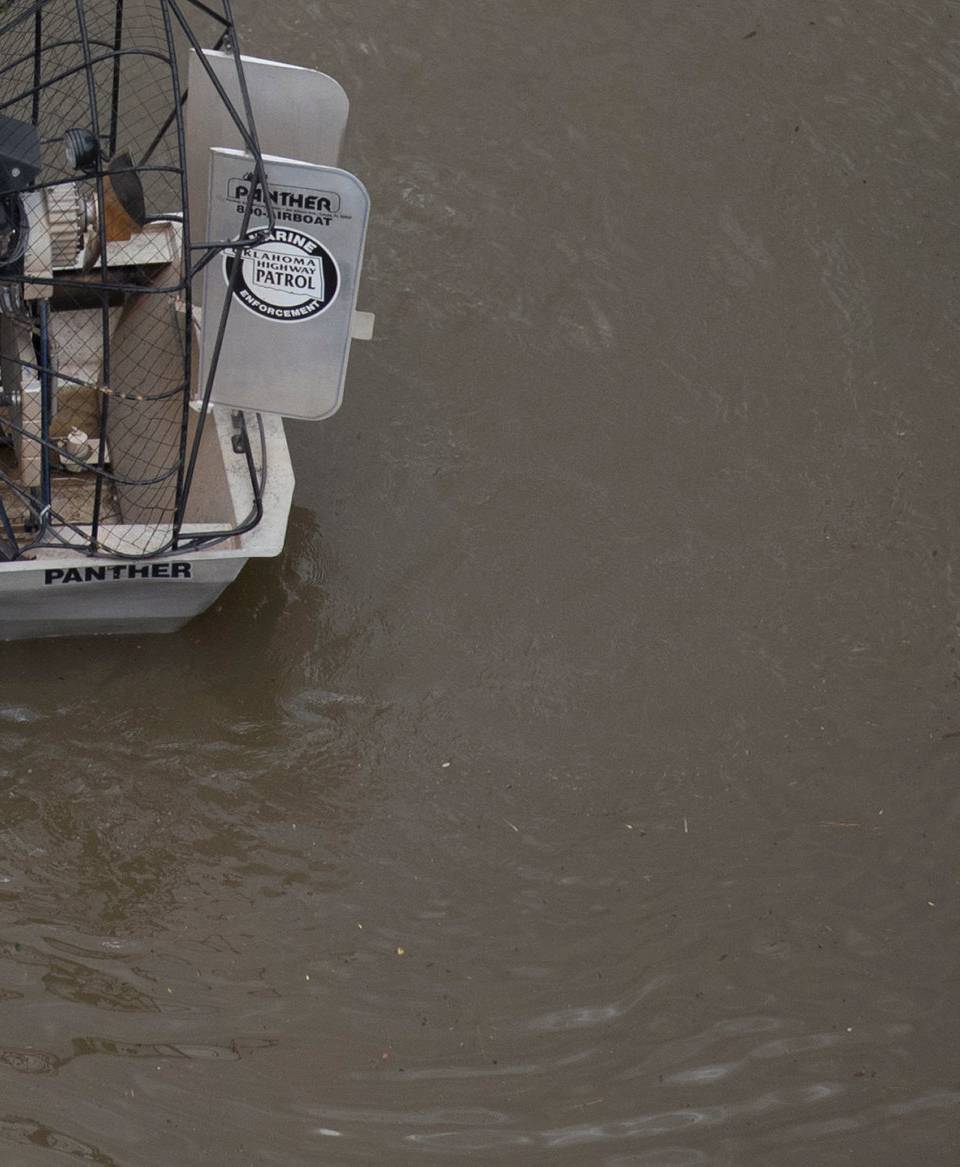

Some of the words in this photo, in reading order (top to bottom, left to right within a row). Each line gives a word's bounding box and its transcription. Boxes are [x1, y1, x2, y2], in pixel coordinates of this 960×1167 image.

[235, 185, 331, 212] PANTHER
[235, 248, 316, 267] KLAHOMA
[256, 260, 316, 275] HIGHWAY
[256, 269, 316, 290] PATROL
[240, 289, 320, 317] ENFORCEMENT
[45, 562, 192, 585] PANTHER
